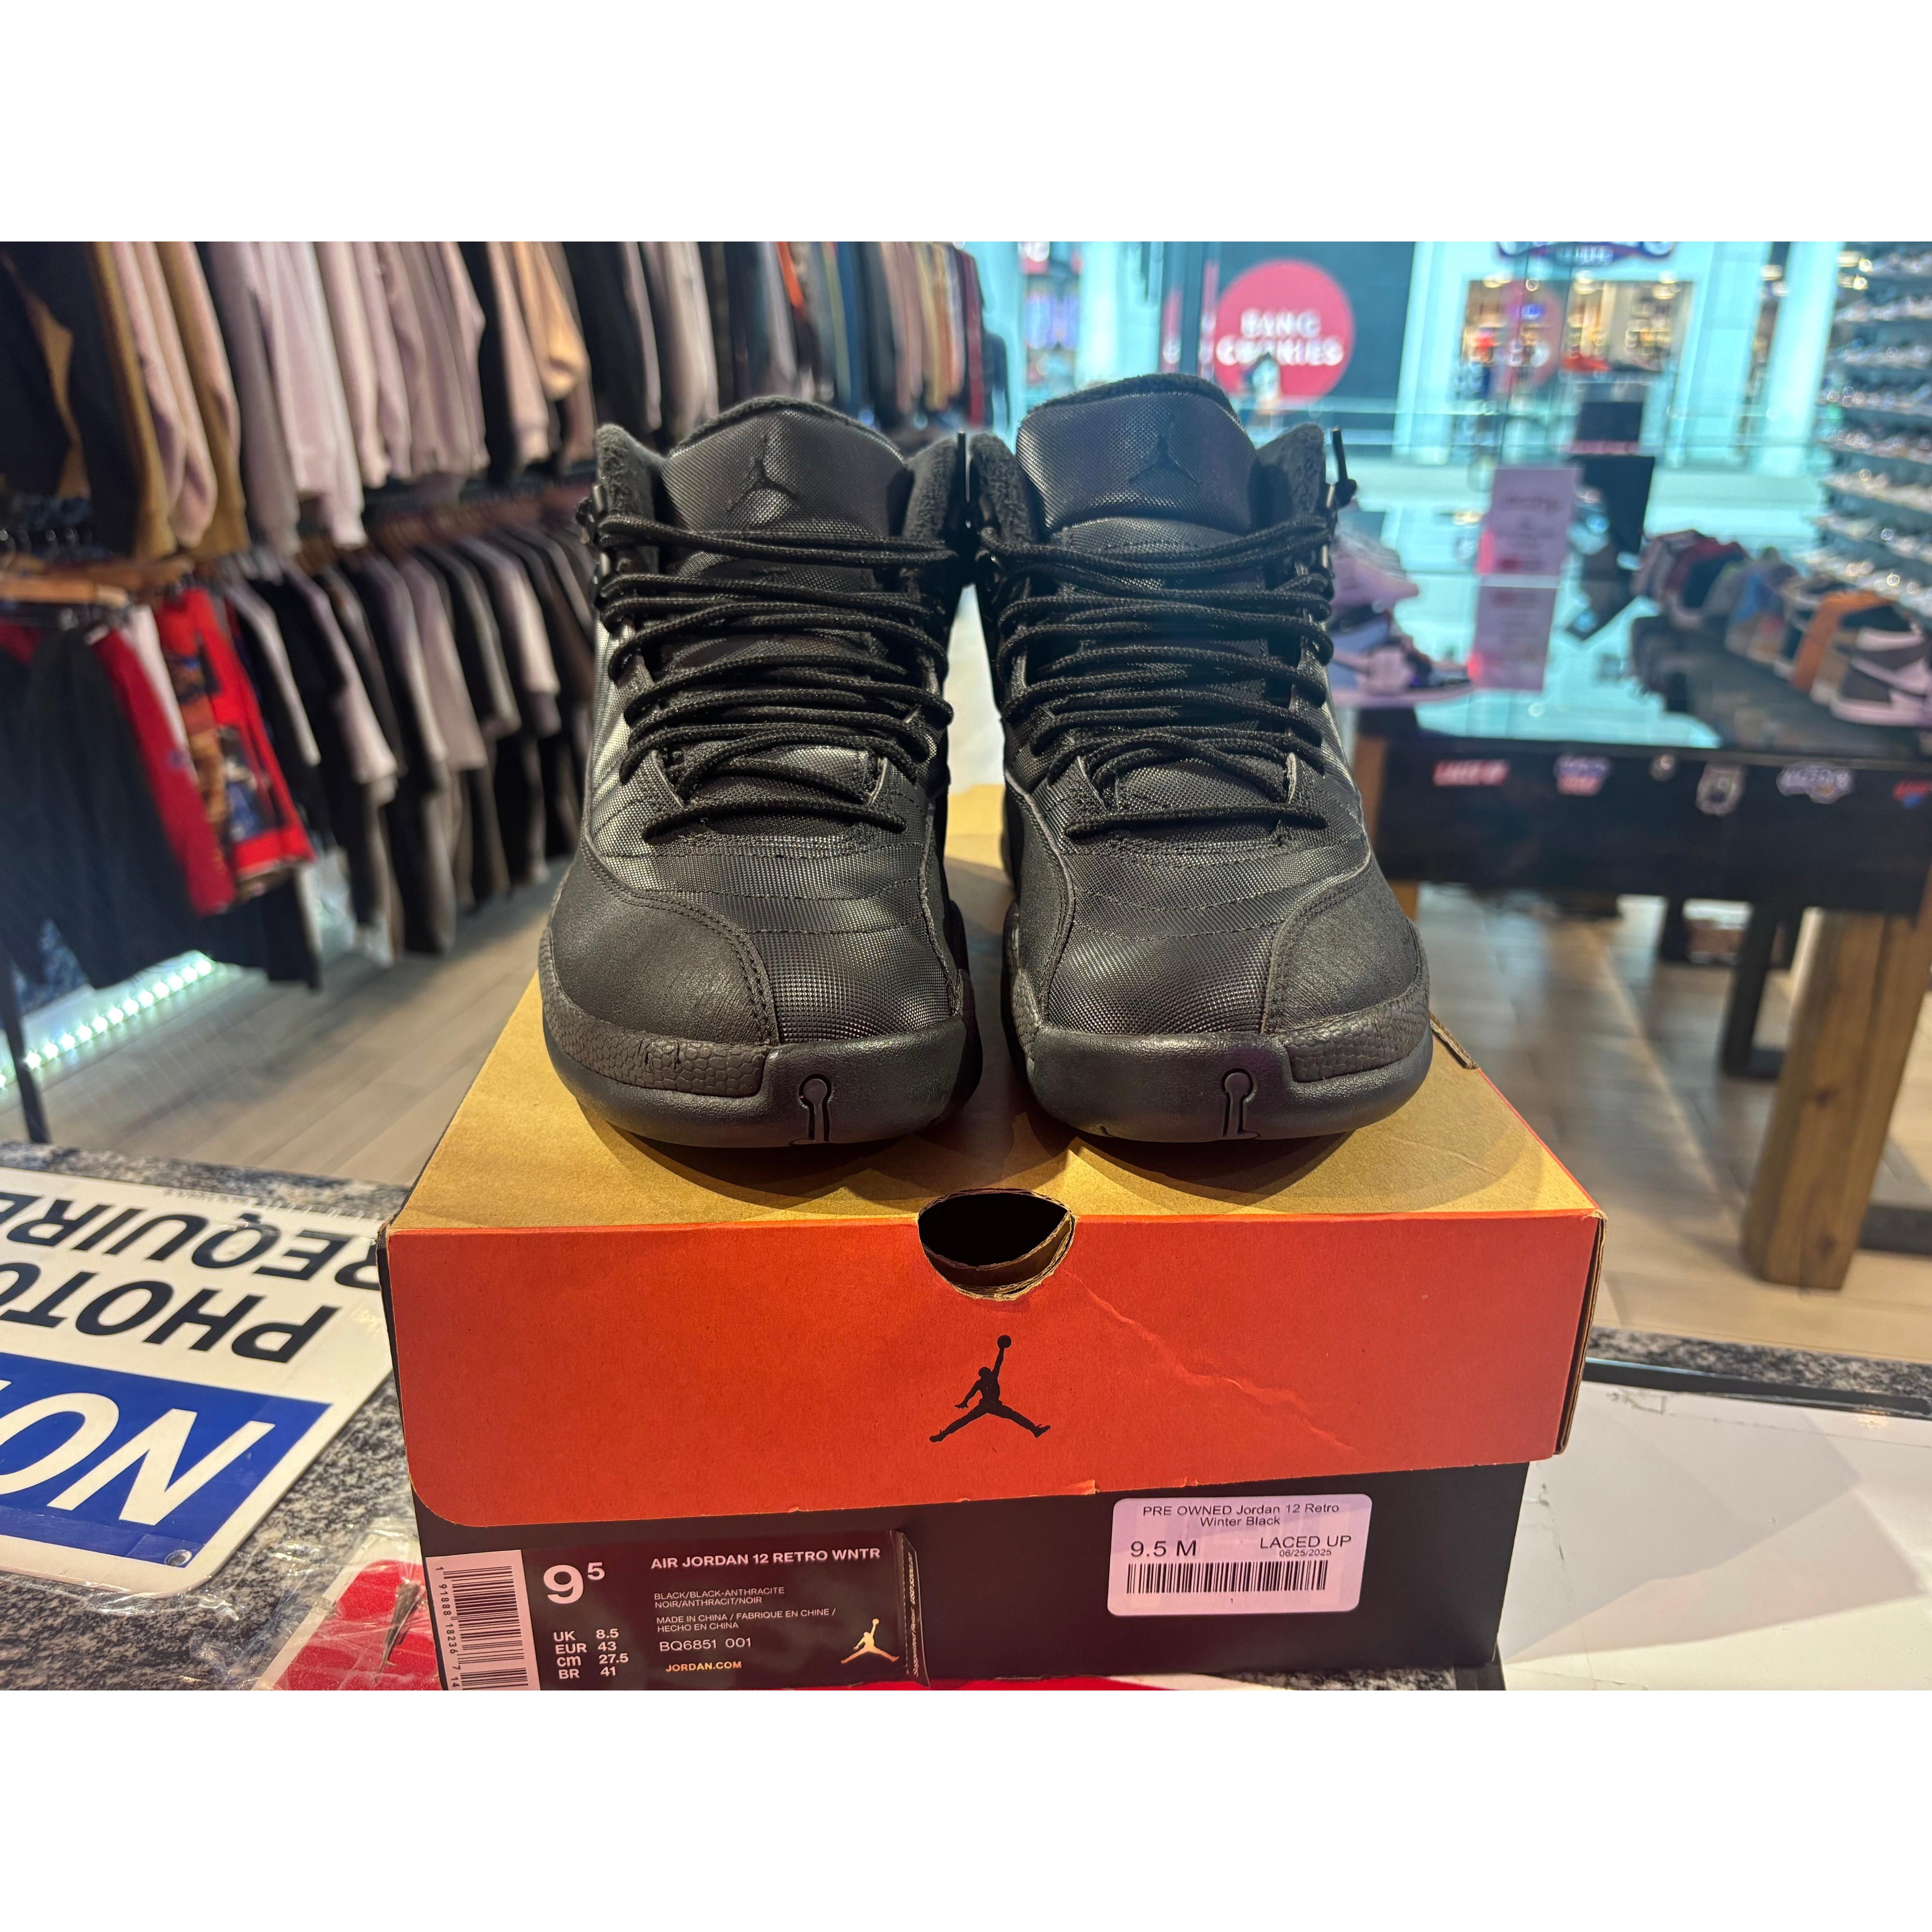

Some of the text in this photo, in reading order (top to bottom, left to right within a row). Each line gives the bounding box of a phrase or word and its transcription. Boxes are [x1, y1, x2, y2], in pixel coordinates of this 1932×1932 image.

[0, 1380, 275, 1525] NO
[1143, 1503, 1339, 1516] PRE OWNED Jordan 12 Retro
[1200, 1516, 1280, 1527] Winter Black
[1131, 1540, 1197, 1558] 9.5 M
[1260, 1535, 1351, 1549] LACED UP
[651, 1548, 881, 1569] AIR JORDAN 12 RETRO WNTR
[1279, 1548, 1332, 1557] 06/25/2025
[543, 1564, 584, 1604] 9
[439, 1584, 452, 1615] 91888
[654, 1587, 785, 1600] BLACK/BLACK-ANTHRACITE
[655, 1596, 762, 1608] NOIR/ANTHRACIT/NOIR
[656, 1616, 684, 1624] MADE
[698, 1614, 728, 1622] CHINA
[730, 1613, 734, 1621] /
[736, 1611, 783, 1620] FABRIQUE
[800, 1608, 830, 1617] CHINE
[831, 1608, 836, 1616] /
[553, 1628, 619, 1642] UK 8.5
[657, 1624, 692, 1633] HECHO
[446, 1623, 458, 1654] 18236
[660, 1637, 752, 1652] BQ6851 001
[555, 1641, 617, 1654] EUR 43
[556, 1653, 629, 1667] cm 27.5
[666, 1661, 742, 1672] JORDAN.COM
[558, 1666, 616, 1679] BR 41
[451, 1677, 460, 1687] 14
